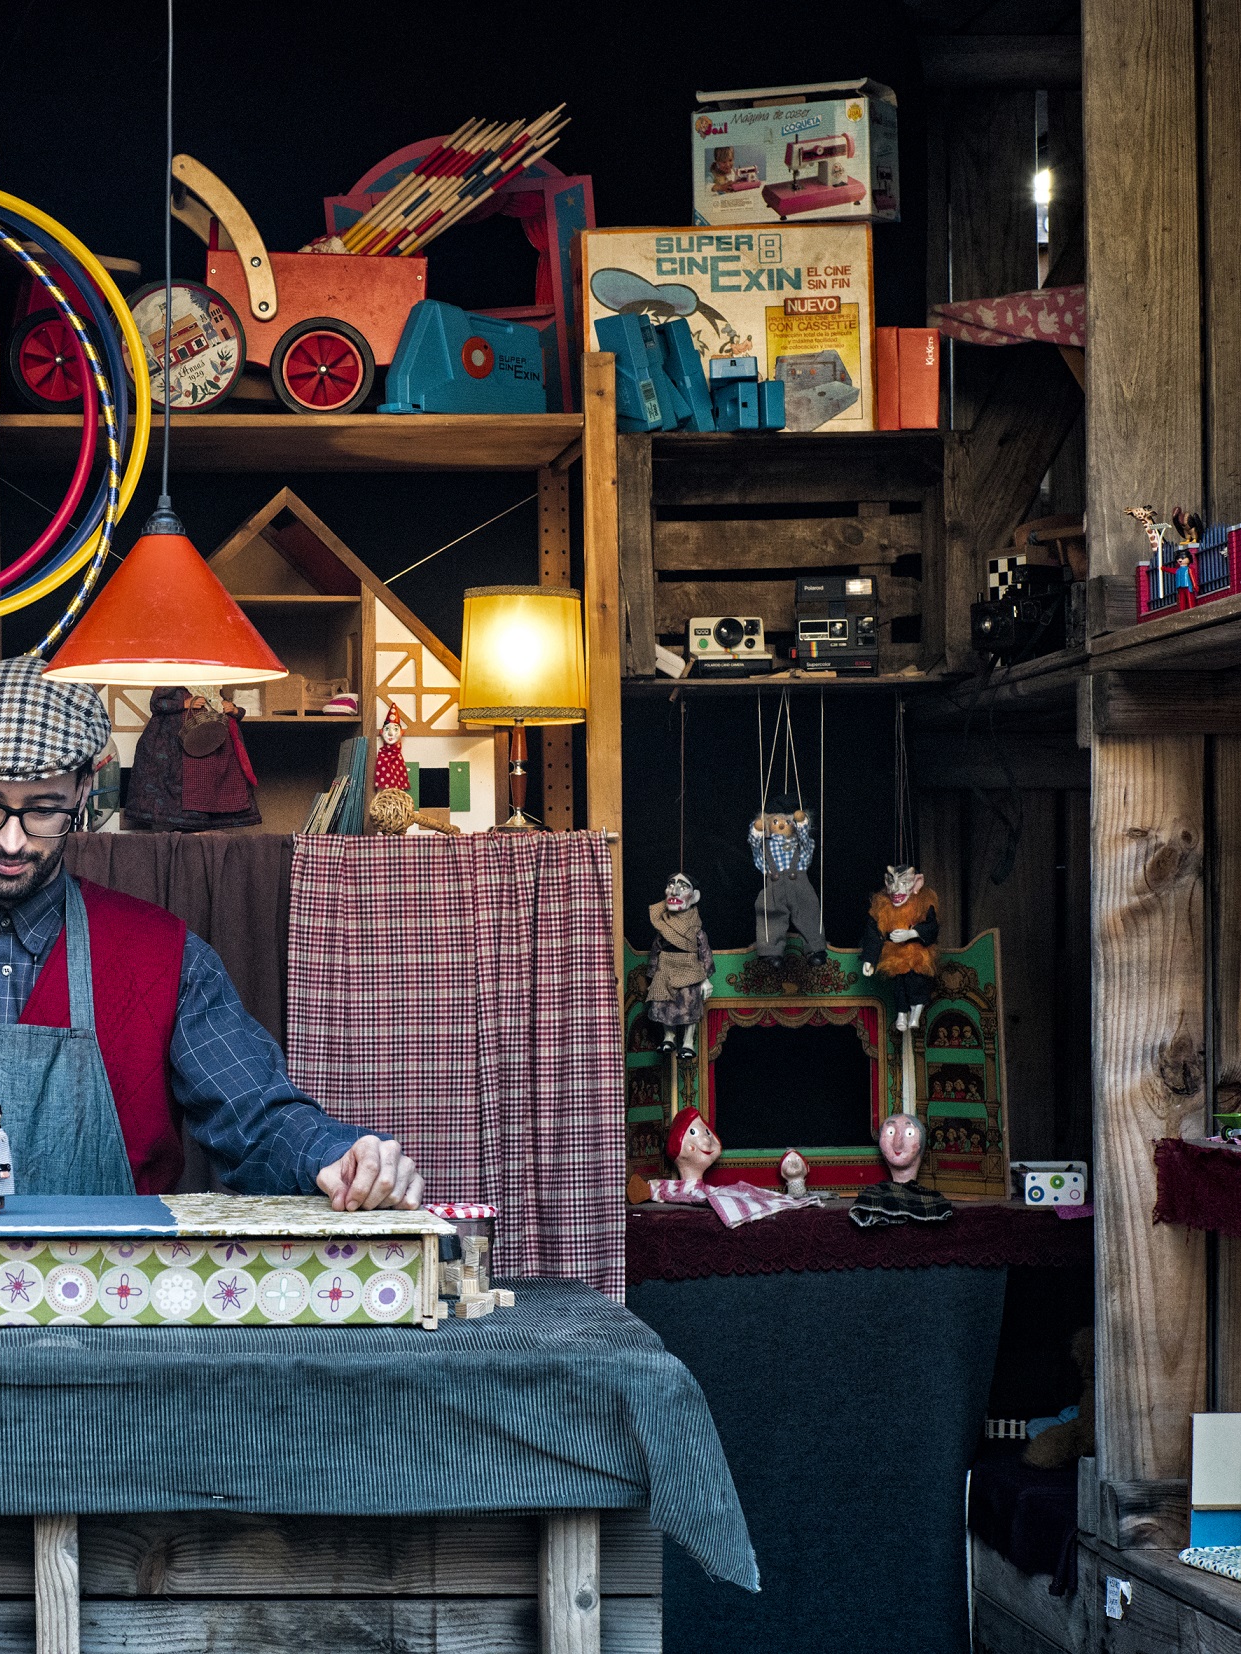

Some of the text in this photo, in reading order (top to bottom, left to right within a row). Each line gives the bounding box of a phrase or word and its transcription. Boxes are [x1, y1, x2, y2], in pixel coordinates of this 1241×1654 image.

[773, 110, 783, 120] de
[786, 109, 811, 120] coser
[784, 116, 820, 132] COQUETA
[656, 234, 782, 264] SUPER 8
[807, 266, 851, 277] EL CINE
[807, 278, 850, 290] SIN FIN
[787, 298, 837, 312] NUEVO
[769, 320, 856, 332] CON CASSETTE
[499, 355, 526, 364] SUPER
